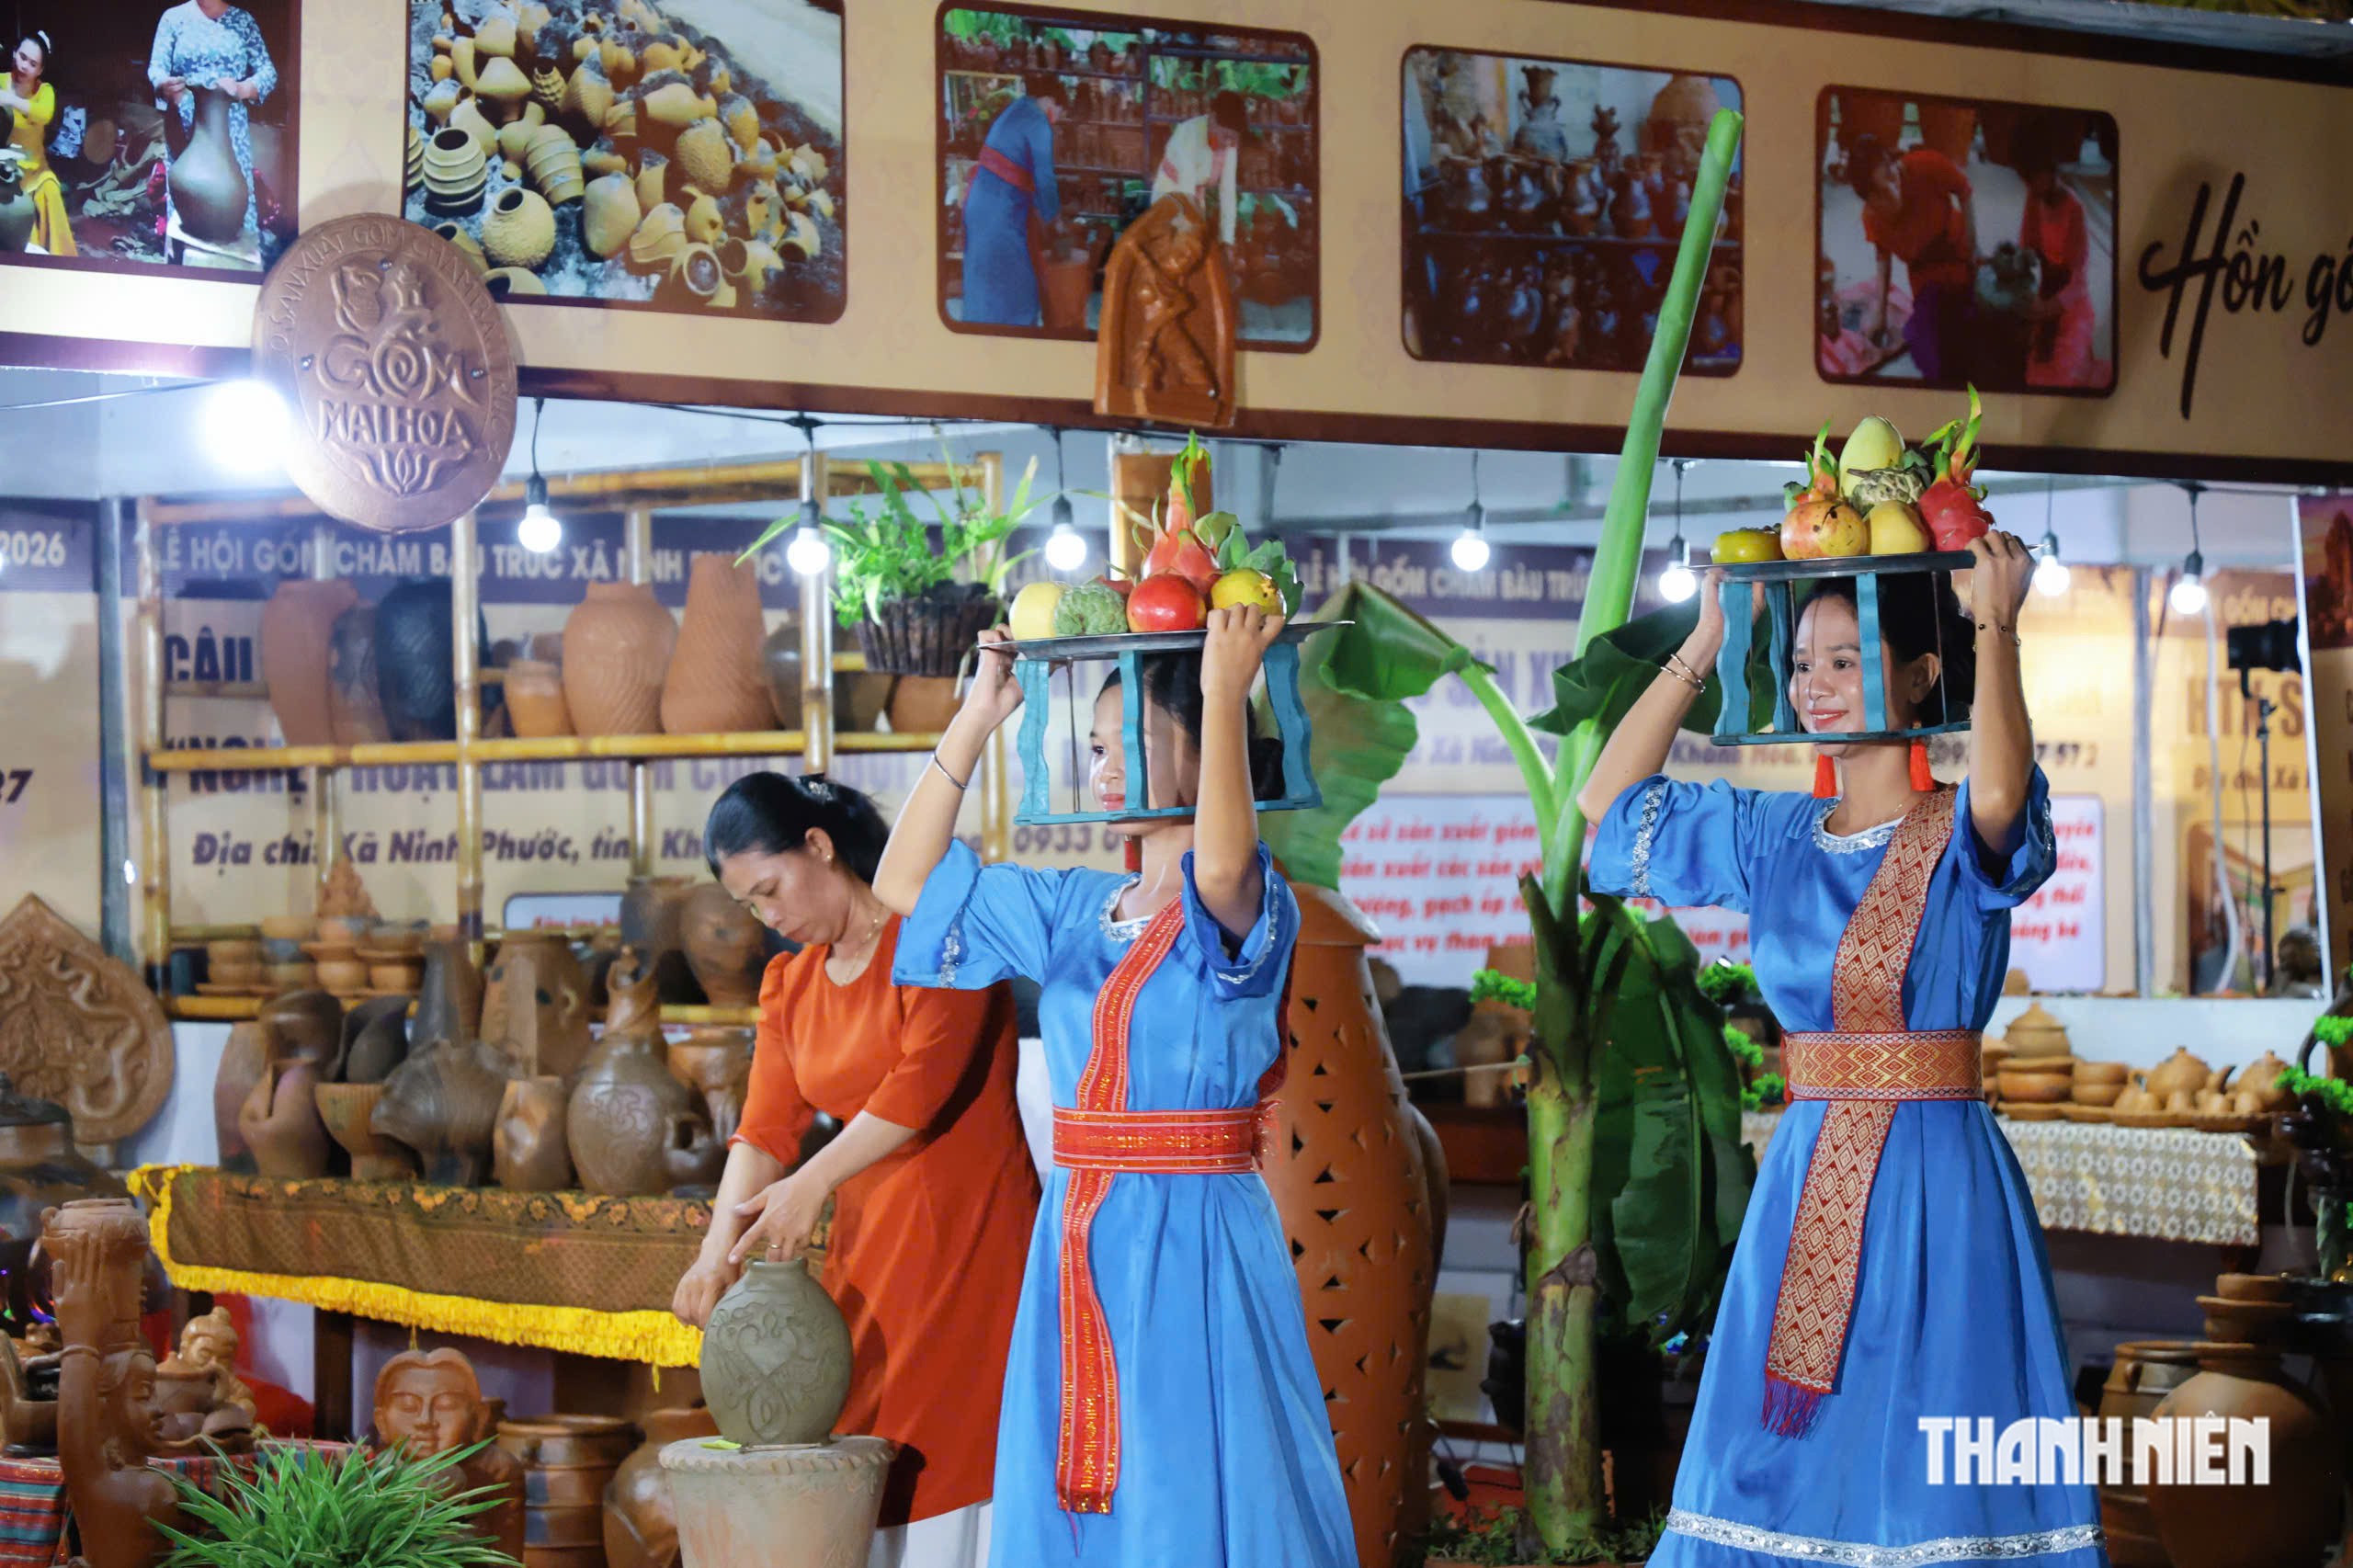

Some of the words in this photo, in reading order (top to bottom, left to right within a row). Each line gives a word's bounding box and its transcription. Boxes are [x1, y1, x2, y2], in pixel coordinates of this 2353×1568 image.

[2138, 171, 2294, 421] Hồn
[190, 529, 244, 582] HỘI
[570, 539, 611, 580] XÃ
[191, 830, 253, 877] Địa
